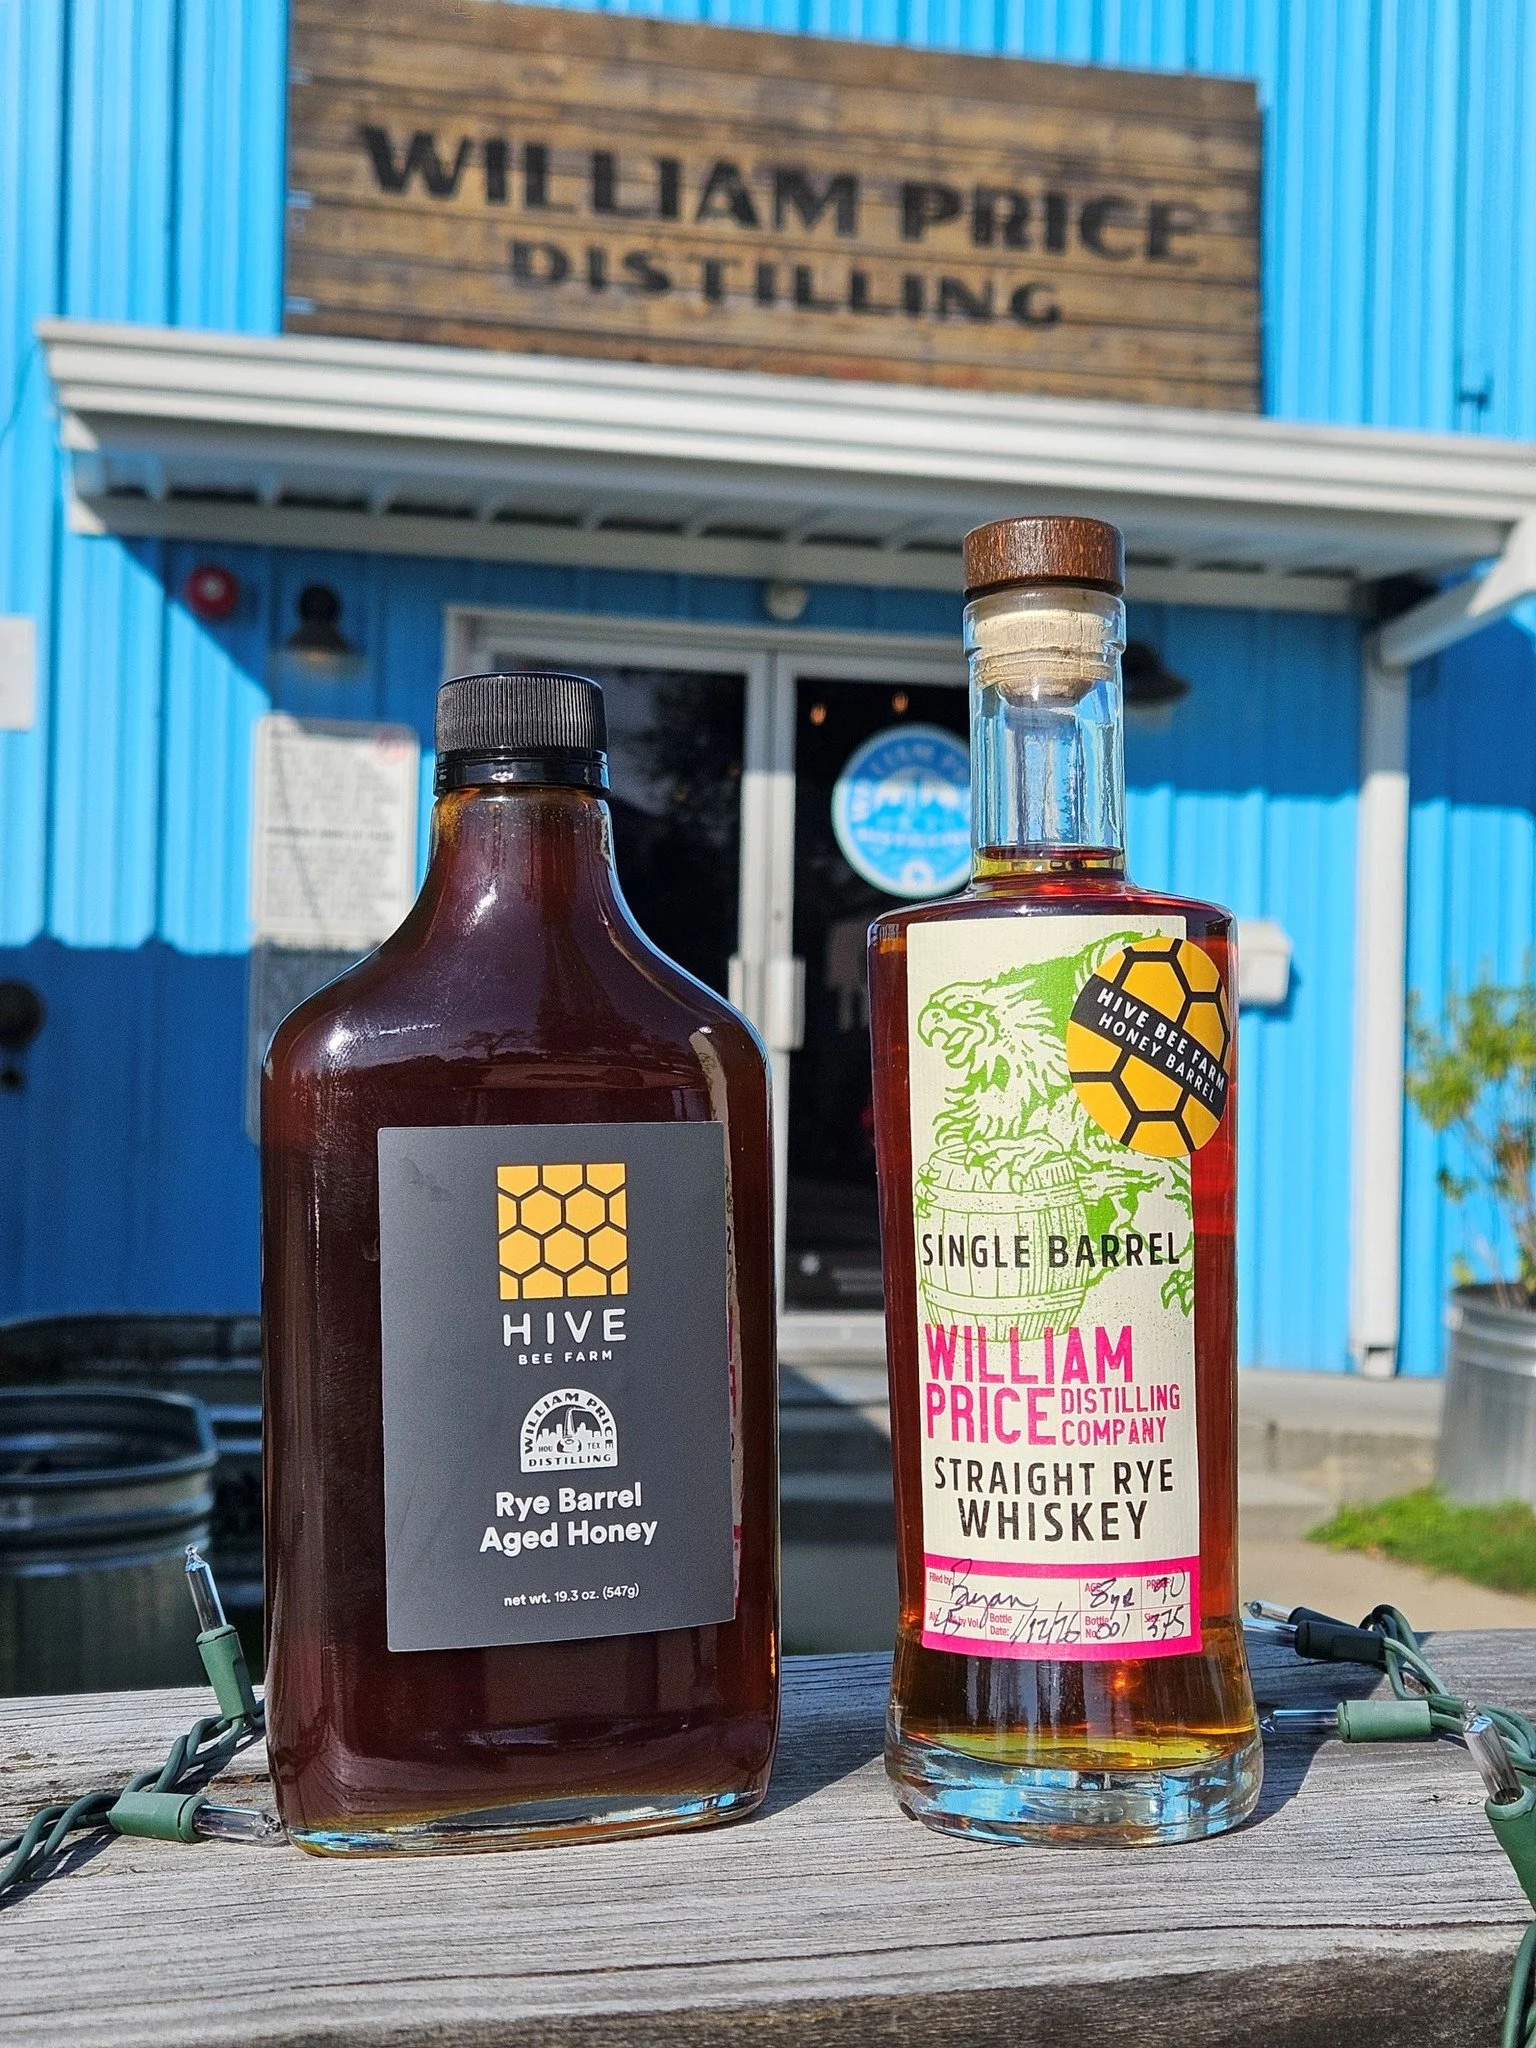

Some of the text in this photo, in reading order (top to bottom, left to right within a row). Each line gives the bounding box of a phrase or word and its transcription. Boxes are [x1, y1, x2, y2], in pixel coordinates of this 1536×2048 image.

[356, 121, 1200, 267] WILLIAM PRICE
[507, 237, 1063, 329] DISTILLING
[1096, 987, 1226, 1092] HIVE BEE FARM
[1098, 1012, 1215, 1104] HONEY BARREL
[921, 1231, 1181, 1269] SINGLE BARREL
[502, 1308, 628, 1348] HIVE
[518, 1349, 613, 1366] BEE FARM
[924, 1322, 1134, 1385] WILLIAM
[523, 1391, 615, 1456] WILLIAM PRICE
[924, 1382, 1182, 1446] PRICE DISTILLING
[1060, 1415, 1168, 1447] COMPANY
[528, 1453, 612, 1468] DISTILLING
[538, 1441, 602, 1453] HOU TEX
[933, 1456, 1175, 1496] STRAIGHT RYE
[495, 1481, 643, 1523] Rye Barrel
[956, 1497, 1148, 1542] WHISKEY
[478, 1519, 659, 1558] Aged Honey
[503, 1582, 640, 1607] net wt. 19.3 oz. (547g)
[989, 1612, 1013, 1624] Bottle
[989, 1625, 1010, 1637] Date:
[1084, 1615, 1110, 1627] Bottle
